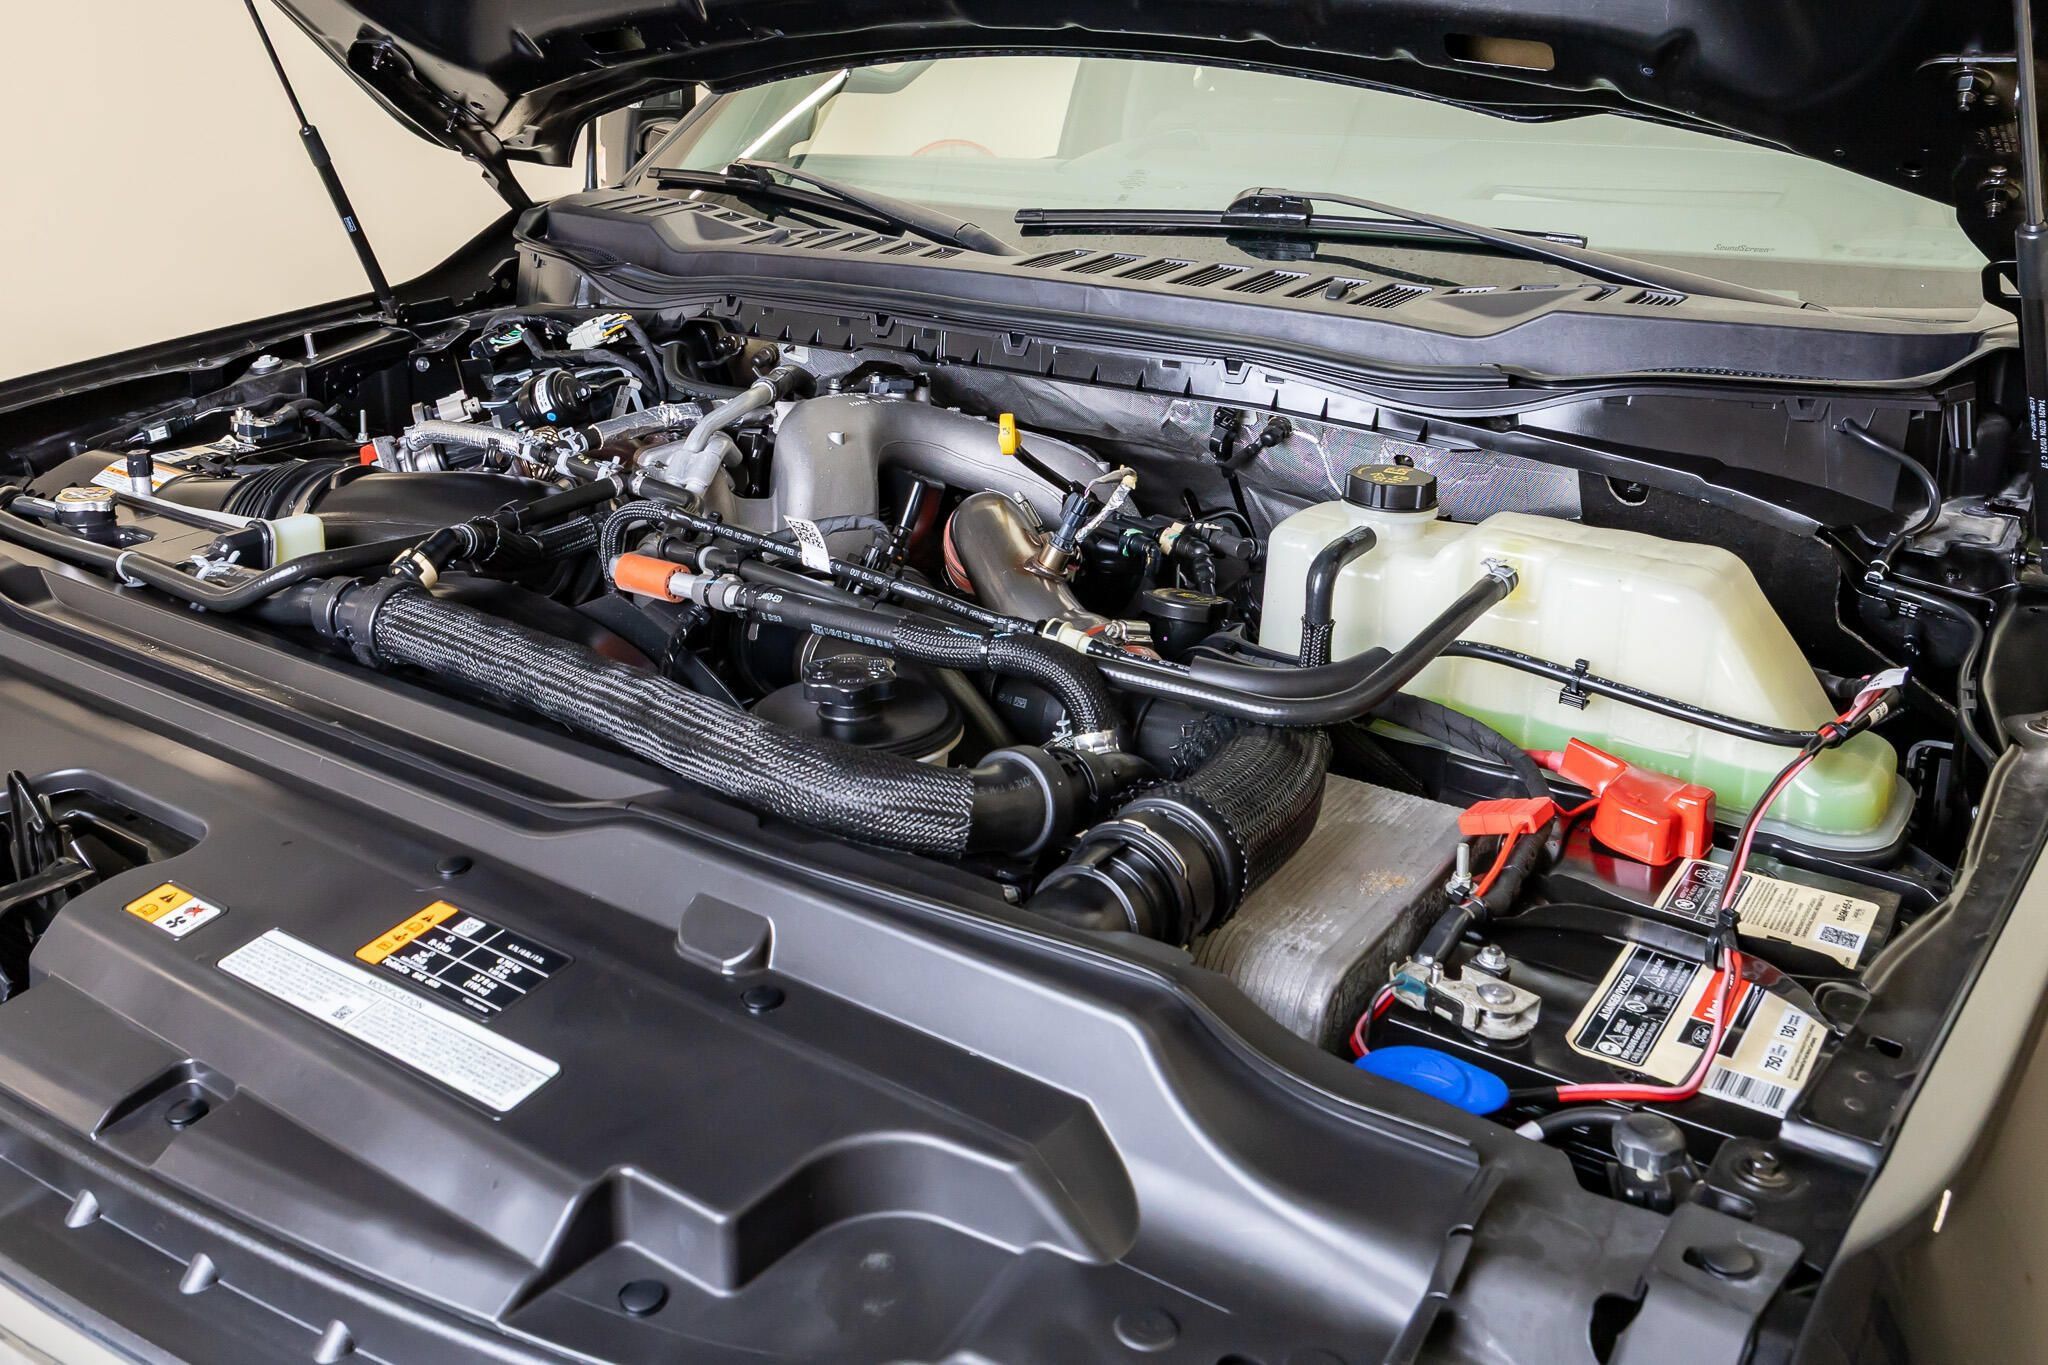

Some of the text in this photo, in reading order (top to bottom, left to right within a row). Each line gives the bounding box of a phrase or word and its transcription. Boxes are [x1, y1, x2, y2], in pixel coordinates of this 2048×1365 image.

[1713, 243, 1769, 253] SoundScreen
[1604, 973, 1636, 1017] DANGER/POISON
[1694, 1028, 1710, 1043] Ford
[1780, 1025, 1797, 1039] 130
[1764, 1055, 1783, 1071] 750
